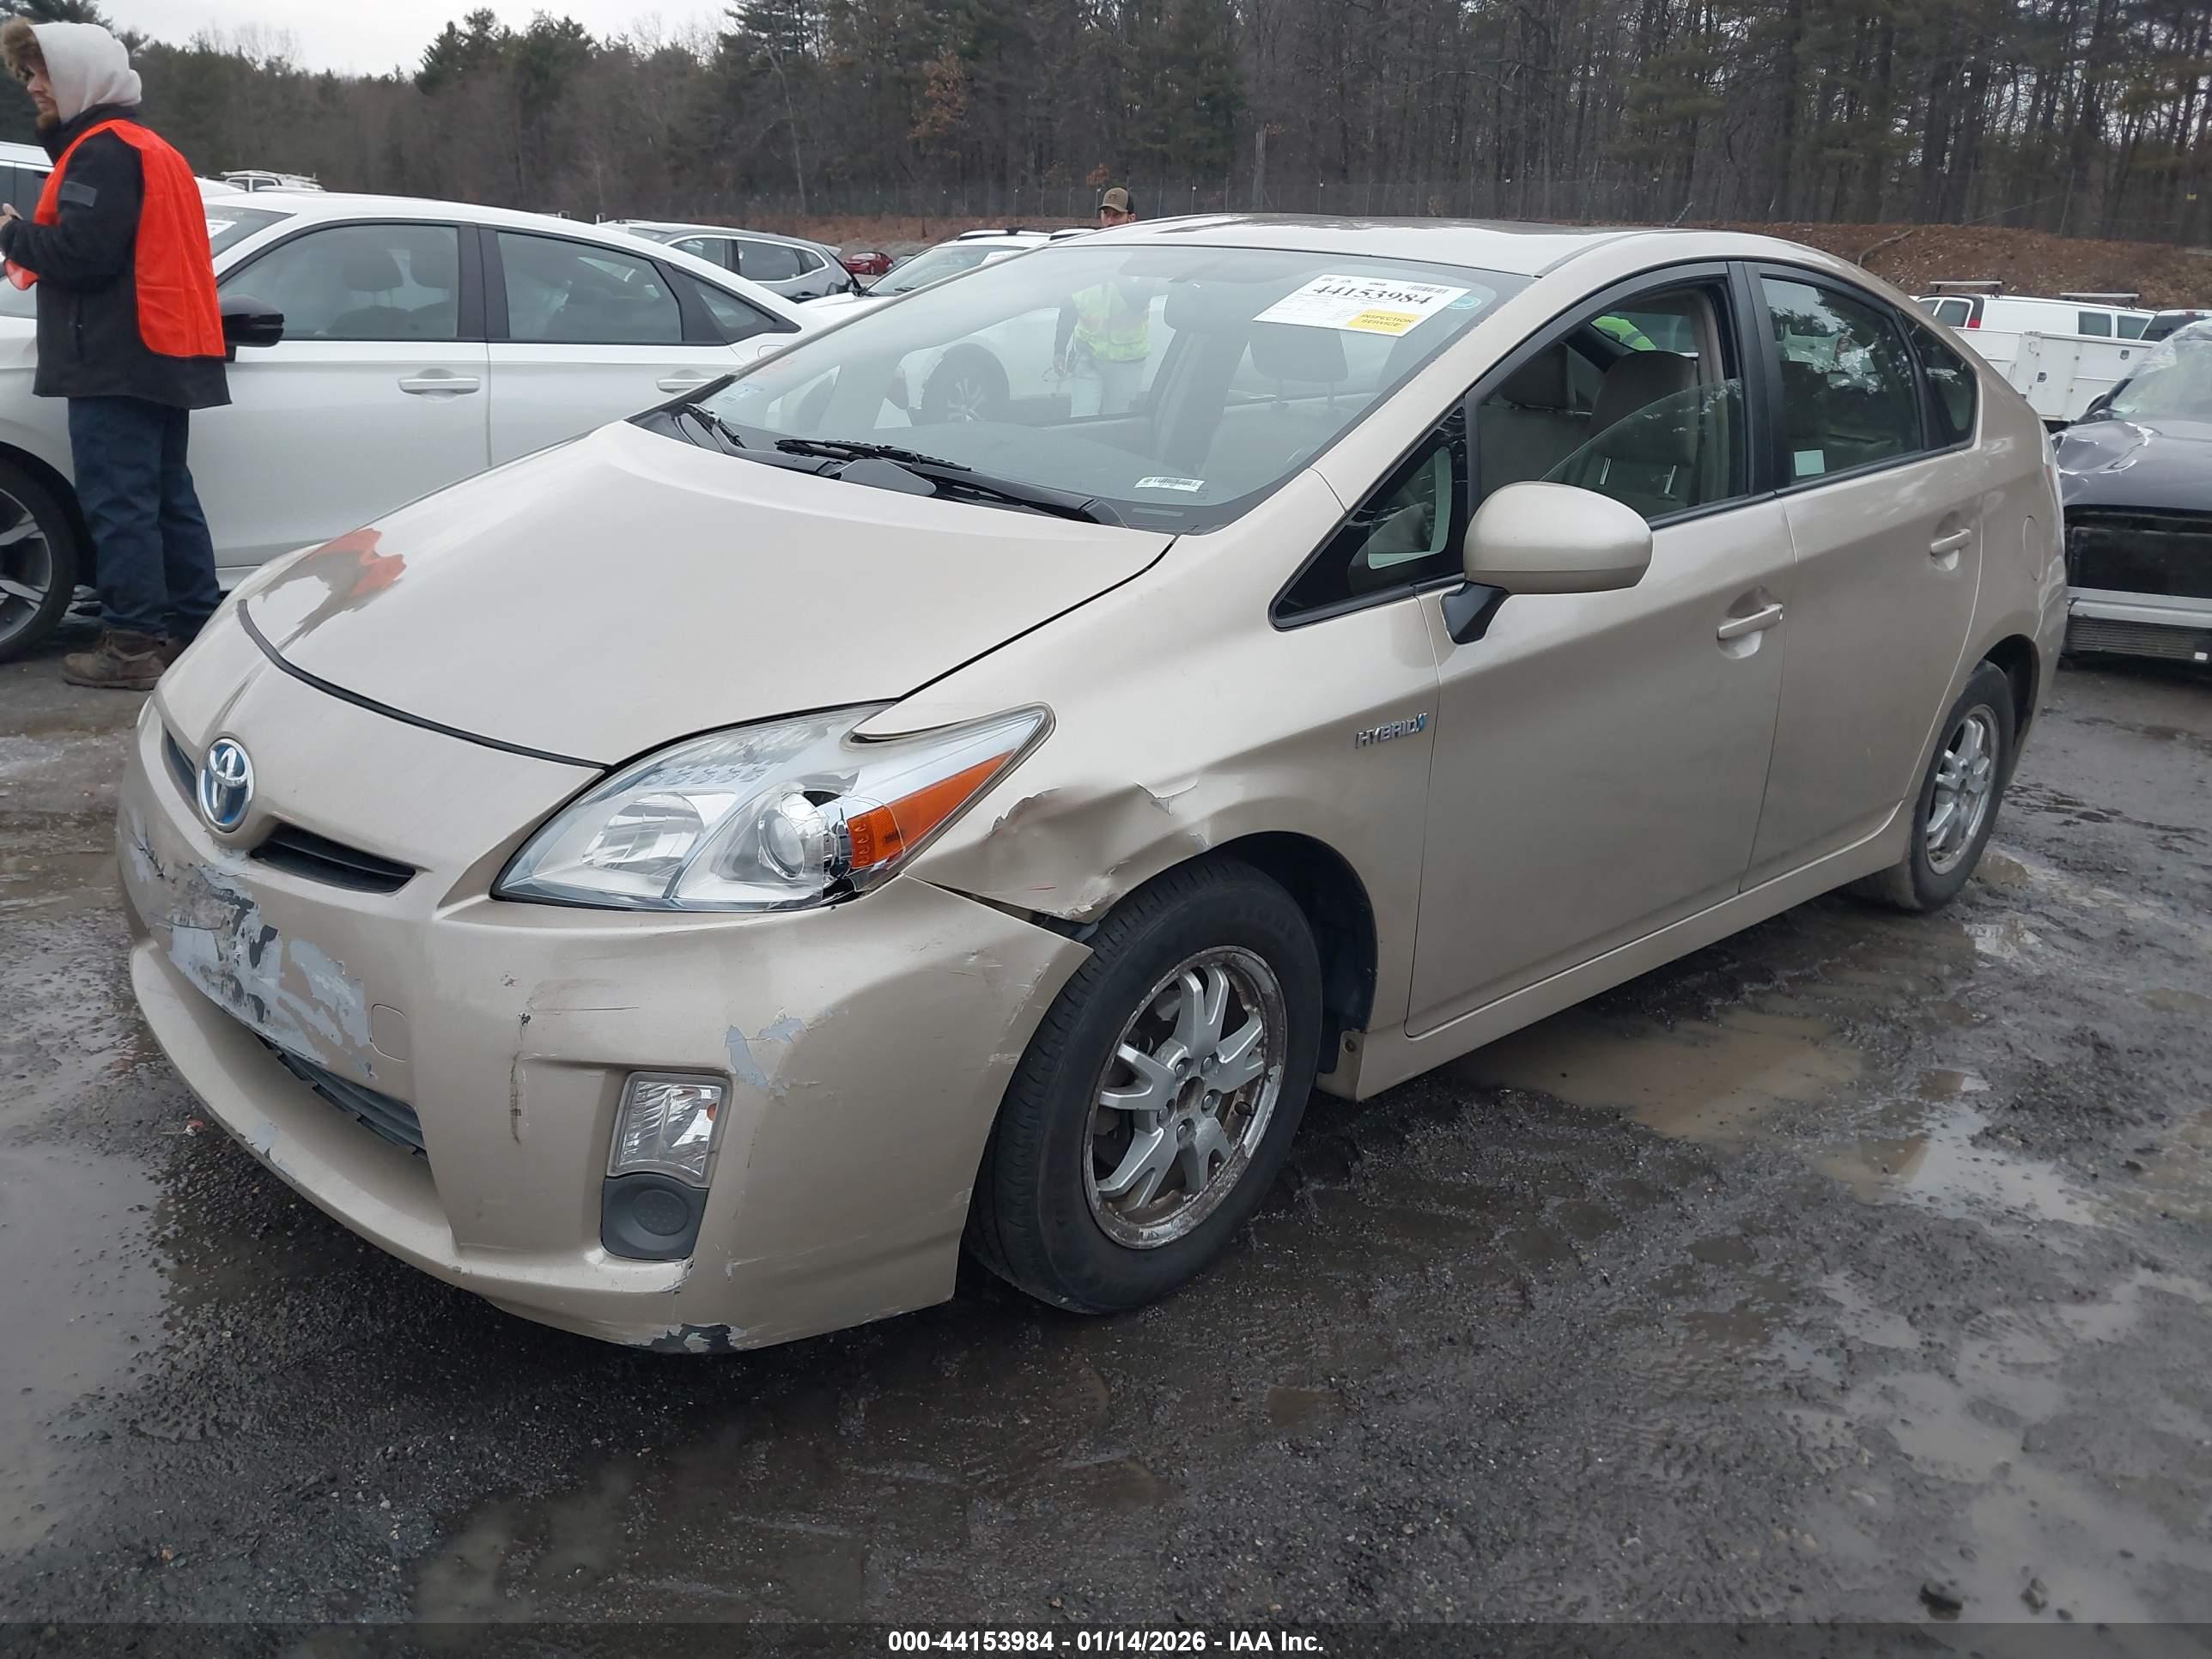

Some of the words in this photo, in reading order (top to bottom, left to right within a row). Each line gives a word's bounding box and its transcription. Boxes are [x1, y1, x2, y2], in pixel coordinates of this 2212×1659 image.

[1312, 285, 1434, 304] 44153984
[1360, 313, 1414, 323] INSPECTION
[1355, 719, 1418, 749] HYBRID
